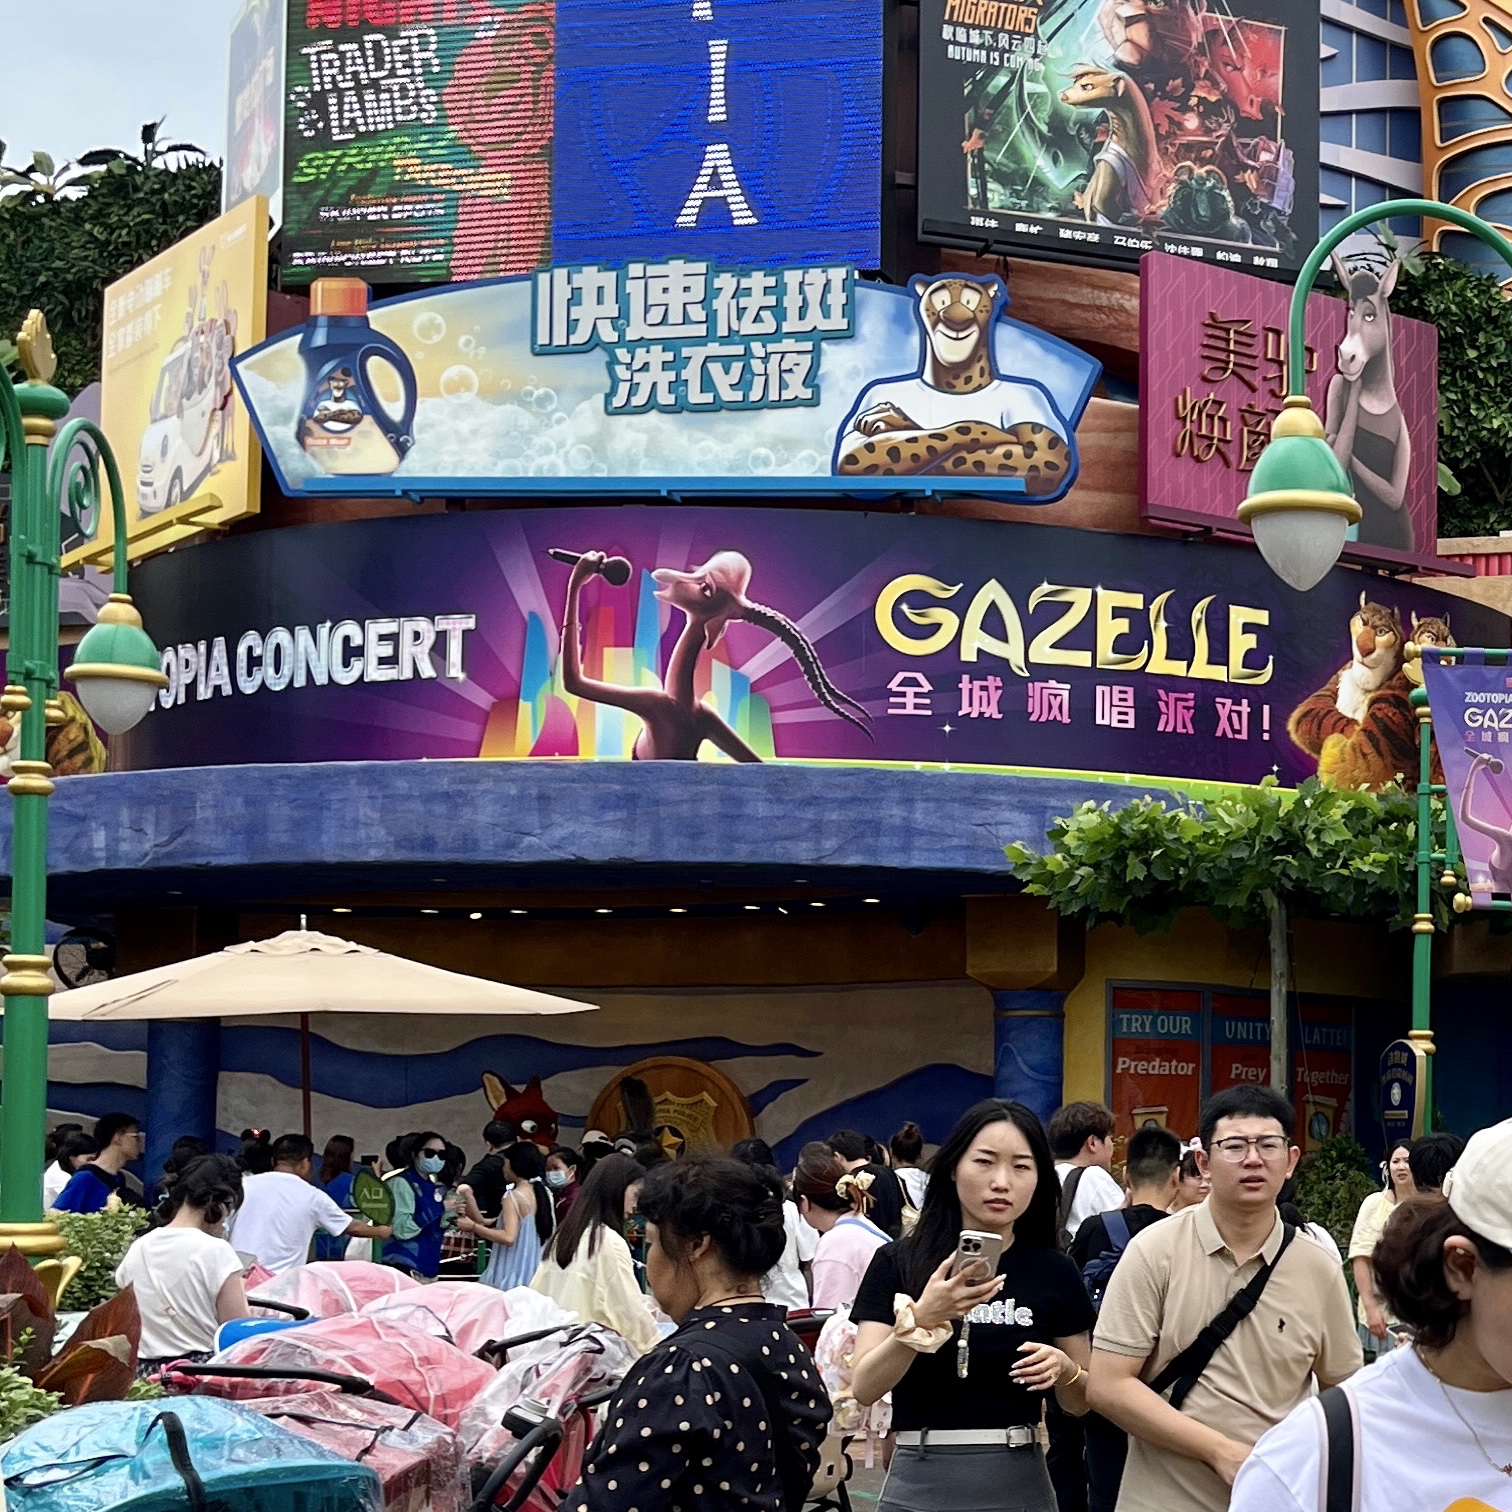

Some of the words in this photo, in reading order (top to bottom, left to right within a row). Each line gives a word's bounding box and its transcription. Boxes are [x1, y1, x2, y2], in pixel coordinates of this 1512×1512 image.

[944, 0, 1038, 33] MIGRATORS
[301, 28, 440, 91] TRADER
[947, 44, 987, 63] AUTUMN
[990, 51, 1000, 66] IS
[1003, 53, 1040, 71] COMNG
[327, 76, 437, 140] LAMBS
[537, 258, 849, 346] 快速祛斑
[611, 339, 816, 409] 洗衣液
[874, 573, 1274, 686] GAZELLE
[149, 636, 232, 712] OPIA
[236, 612, 477, 695] CONCERT
[886, 671, 1272, 741] 全城疯唱派对!
[1120, 1014, 1151, 1033] TRY
[1157, 1016, 1192, 1035] OUR
[1225, 1020, 1271, 1041] UNITY
[1116, 1057, 1196, 1076] Predator
[1230, 1063, 1267, 1083] Prey
[1296, 1067, 1350, 1086] Together
[360, 1187, 383, 1199] 入口
[968, 1298, 1034, 1326] ntle
